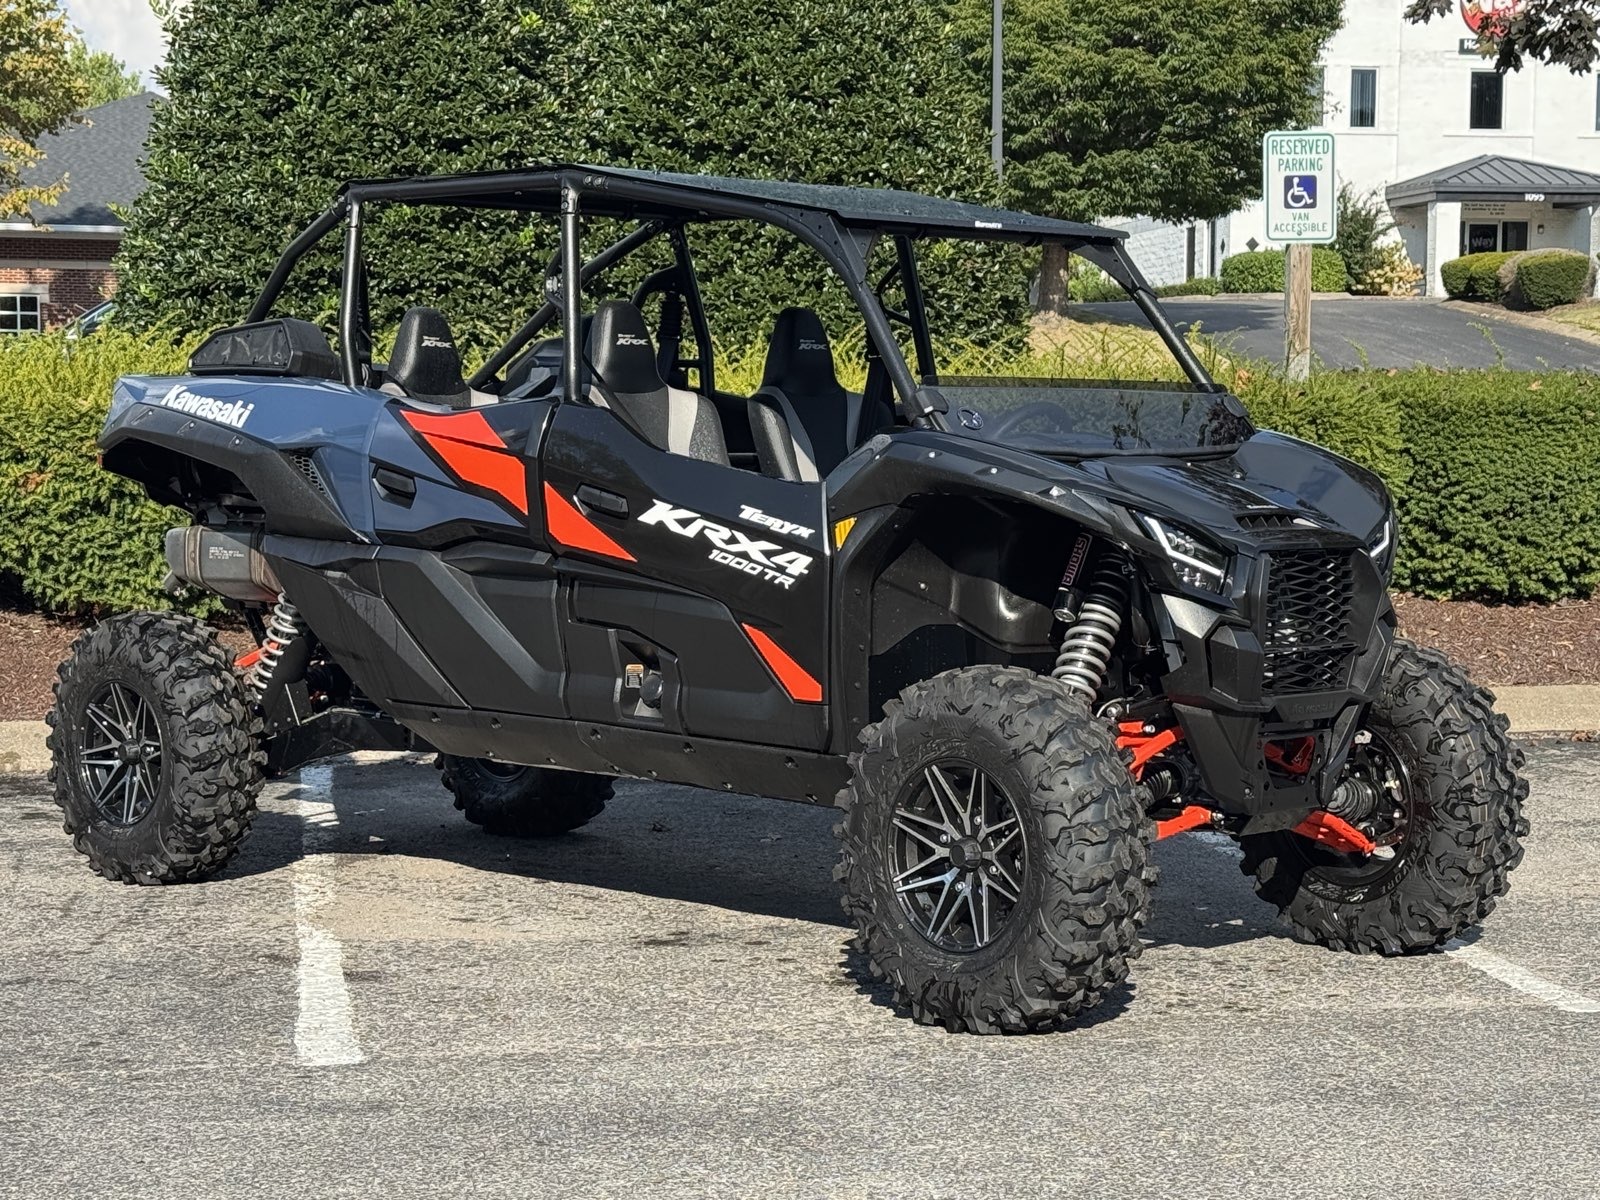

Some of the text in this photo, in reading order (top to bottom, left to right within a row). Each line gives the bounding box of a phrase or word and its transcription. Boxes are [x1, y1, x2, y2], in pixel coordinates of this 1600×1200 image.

[1271, 138, 1330, 155] RESERVED
[1278, 157, 1323, 172] PARKING
[1291, 212, 1310, 221] VAN
[1273, 222, 1328, 233] ACCESSIBLE
[616, 337, 649, 346] KRX
[160, 384, 255, 428] Kawasaki
[637, 498, 814, 576] KRX4
